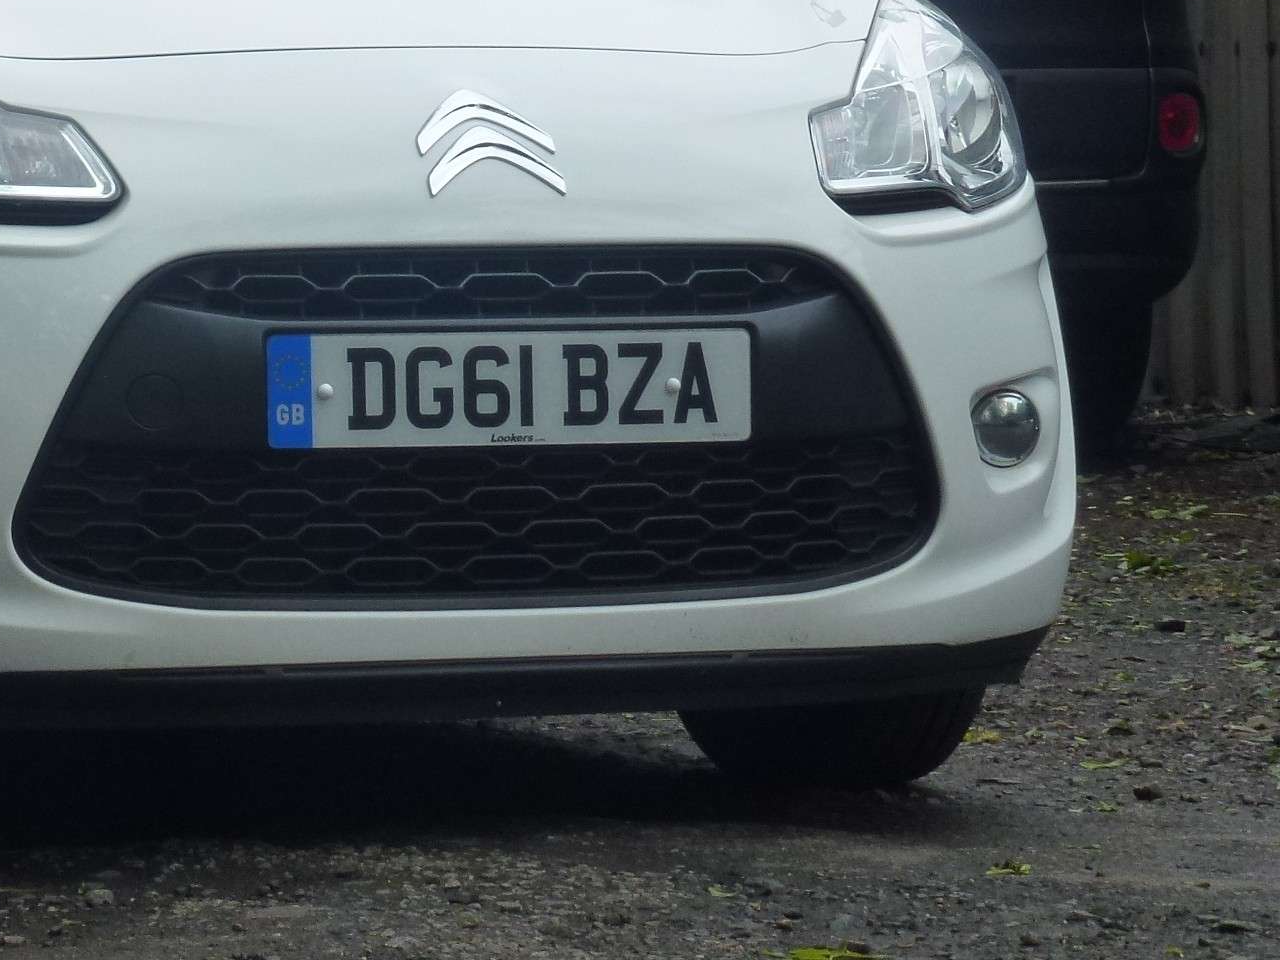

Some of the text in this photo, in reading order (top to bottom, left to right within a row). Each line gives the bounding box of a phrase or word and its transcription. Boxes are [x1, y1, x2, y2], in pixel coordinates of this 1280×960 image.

[346, 341, 719, 430] DG61 BZA
[276, 403, 305, 426] GB
[491, 432, 534, 443] Lookers
